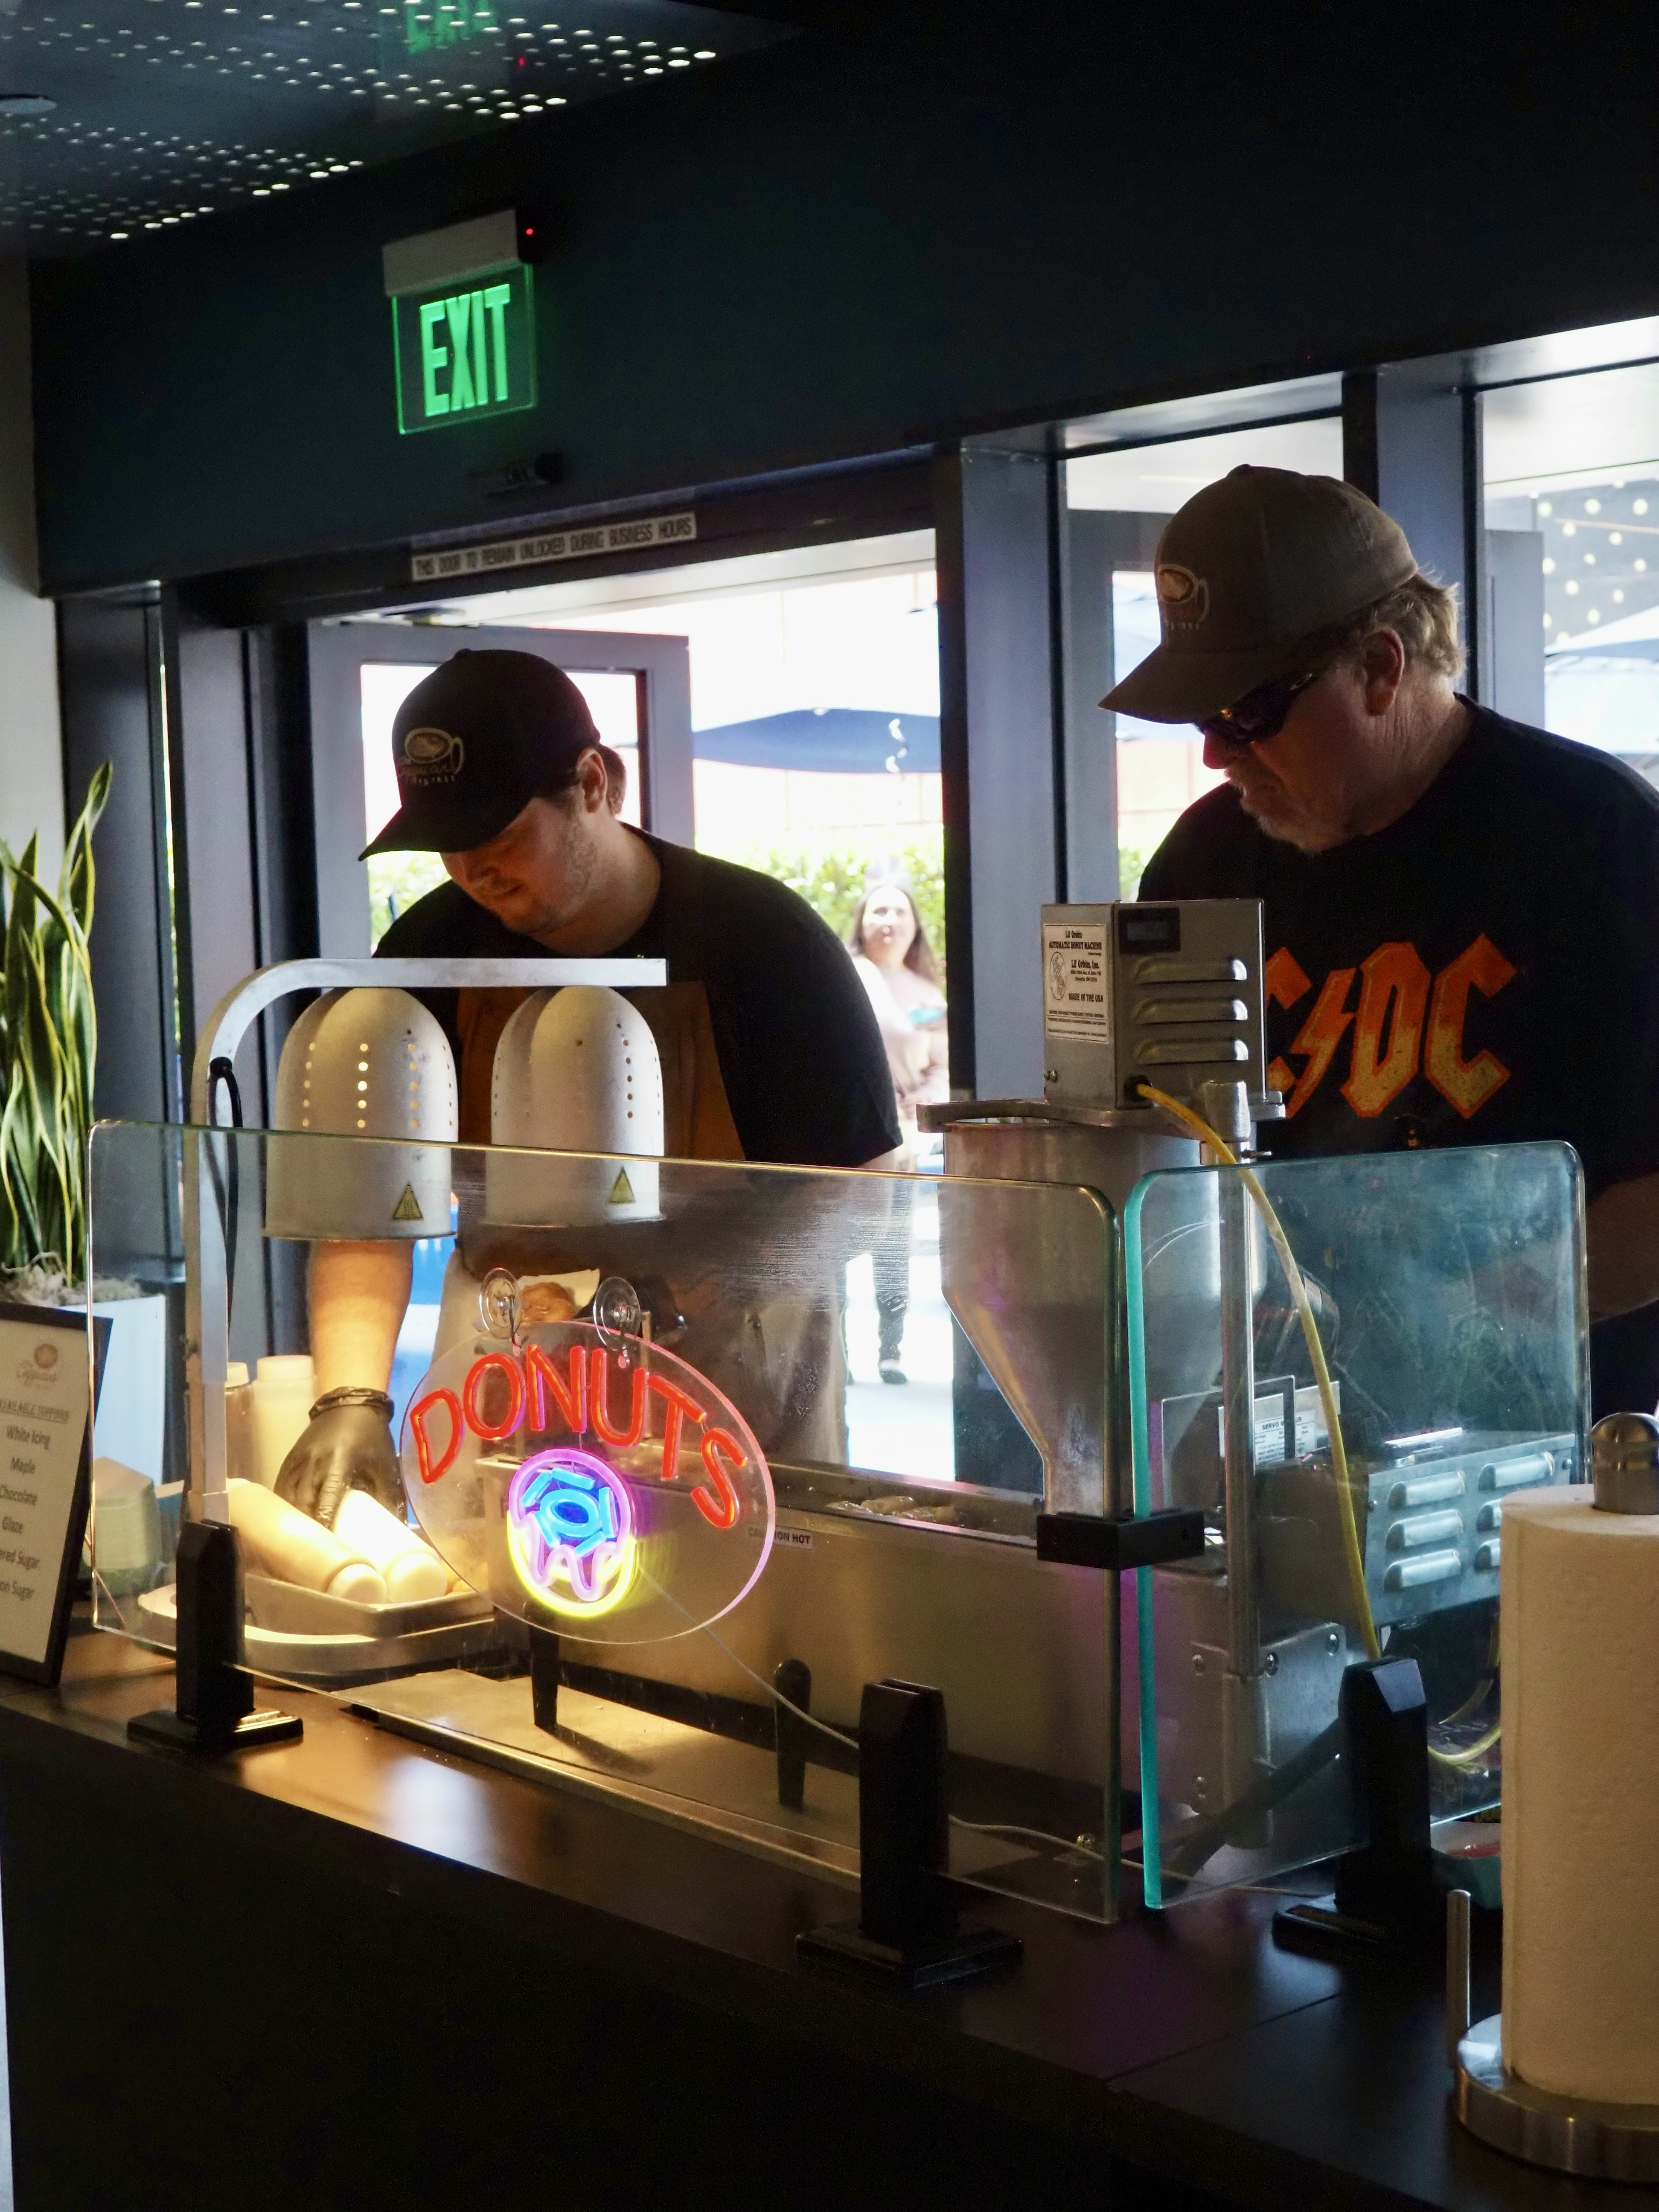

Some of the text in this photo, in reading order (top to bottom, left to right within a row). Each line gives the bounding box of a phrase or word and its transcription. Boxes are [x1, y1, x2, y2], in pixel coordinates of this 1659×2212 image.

[419, 284, 510, 417] EXIT
[609, 523, 653, 546] BUSINESS
[659, 517, 693, 539] HOURS
[1262, 1421, 1279, 1430] SERVO
[7, 1426, 50, 1449] White Icing
[410, 1344, 747, 1529] DONUTS
[11, 1457, 35, 1475] Maple
[0, 1484, 38, 1505] Chocolate
[3, 1516, 23, 1534] Glaze
[792, 1533, 810, 1544] HOT
[17, 1551, 40, 1571] Sugar
[12, 1581, 35, 1601] Sugar
